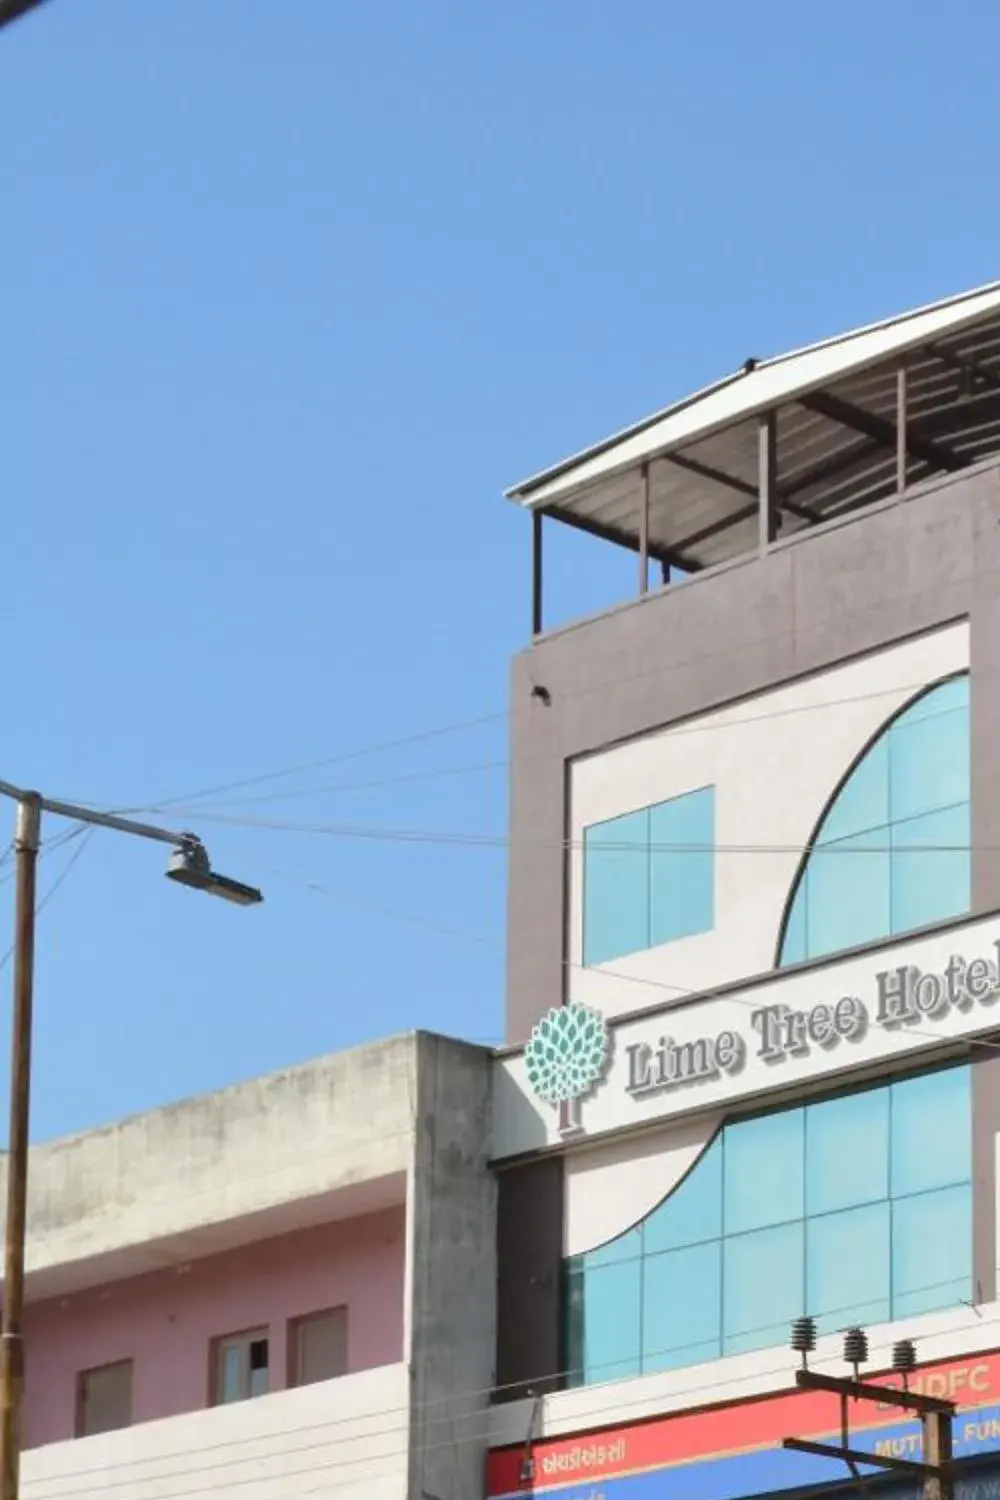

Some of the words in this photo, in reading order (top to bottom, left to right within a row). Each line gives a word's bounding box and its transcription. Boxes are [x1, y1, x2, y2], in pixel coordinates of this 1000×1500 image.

[624, 1028, 745, 1093] Lime
[751, 995, 867, 1061] Tree
[873, 1433, 959, 1460] MUT
